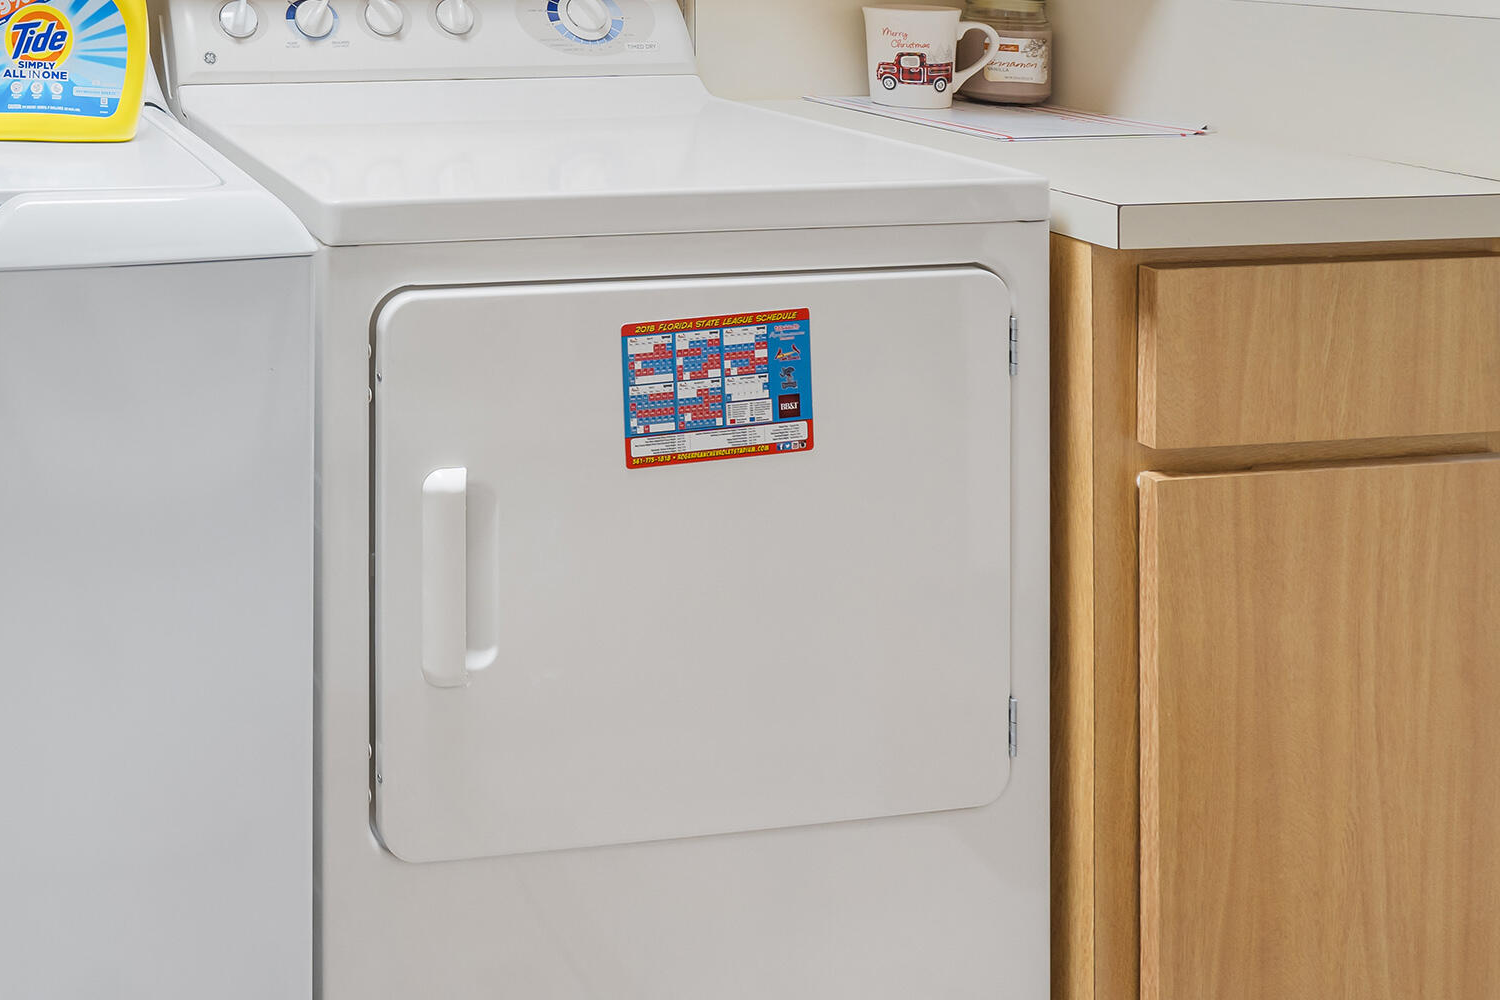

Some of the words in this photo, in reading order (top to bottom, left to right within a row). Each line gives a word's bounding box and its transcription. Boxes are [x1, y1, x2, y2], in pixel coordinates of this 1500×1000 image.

[12, 19, 68, 60] Tide
[881, 27, 909, 40] Merry
[890, 39, 930, 49] Christmas
[18, 61, 55, 70] SIMPLY
[635, 325, 655, 333] 2018
[658, 322, 693, 331] FLORIDA
[696, 319, 720, 328] STATE
[722, 315, 754, 325] LEAGUE
[755, 312, 798, 321] SCHEDULE
